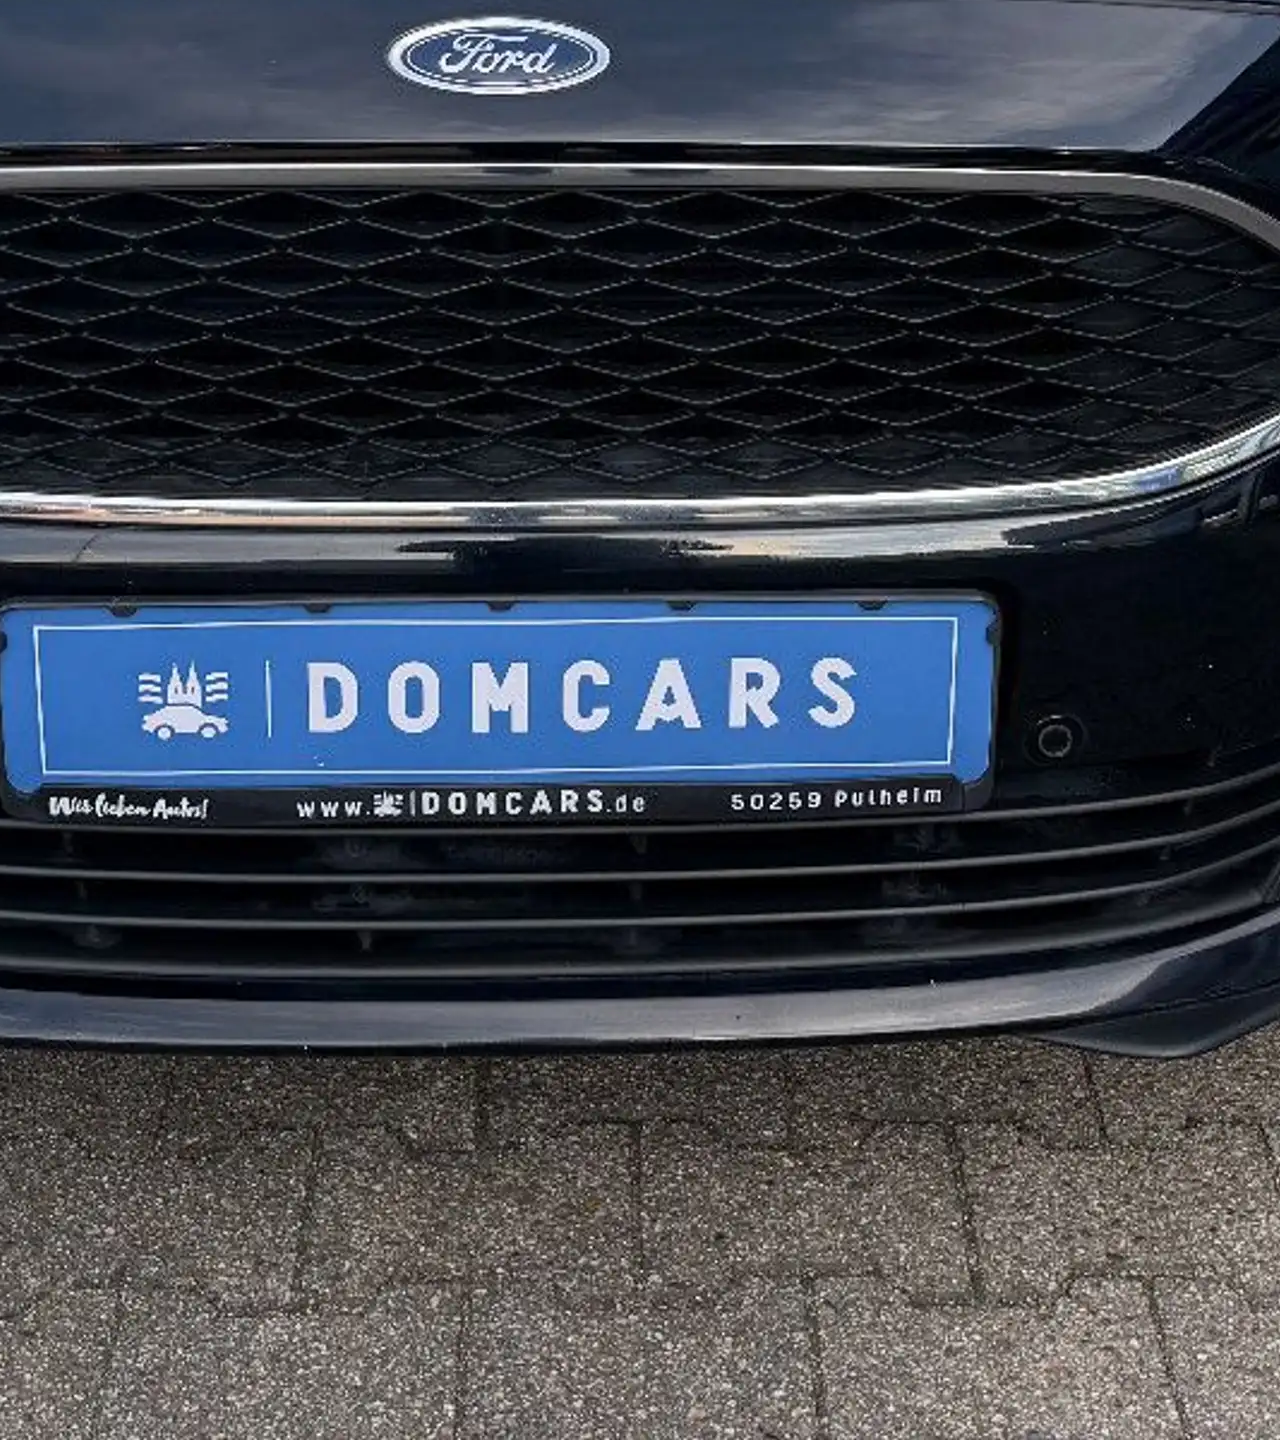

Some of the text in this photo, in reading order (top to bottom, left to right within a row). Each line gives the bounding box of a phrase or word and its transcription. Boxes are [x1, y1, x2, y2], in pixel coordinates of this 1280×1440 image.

[437, 33, 559, 74] Ford
[306, 656, 858, 734] DOMCARS
[152, 795, 210, 820] Autos!
[730, 786, 943, 811] 50259 Pulheim
